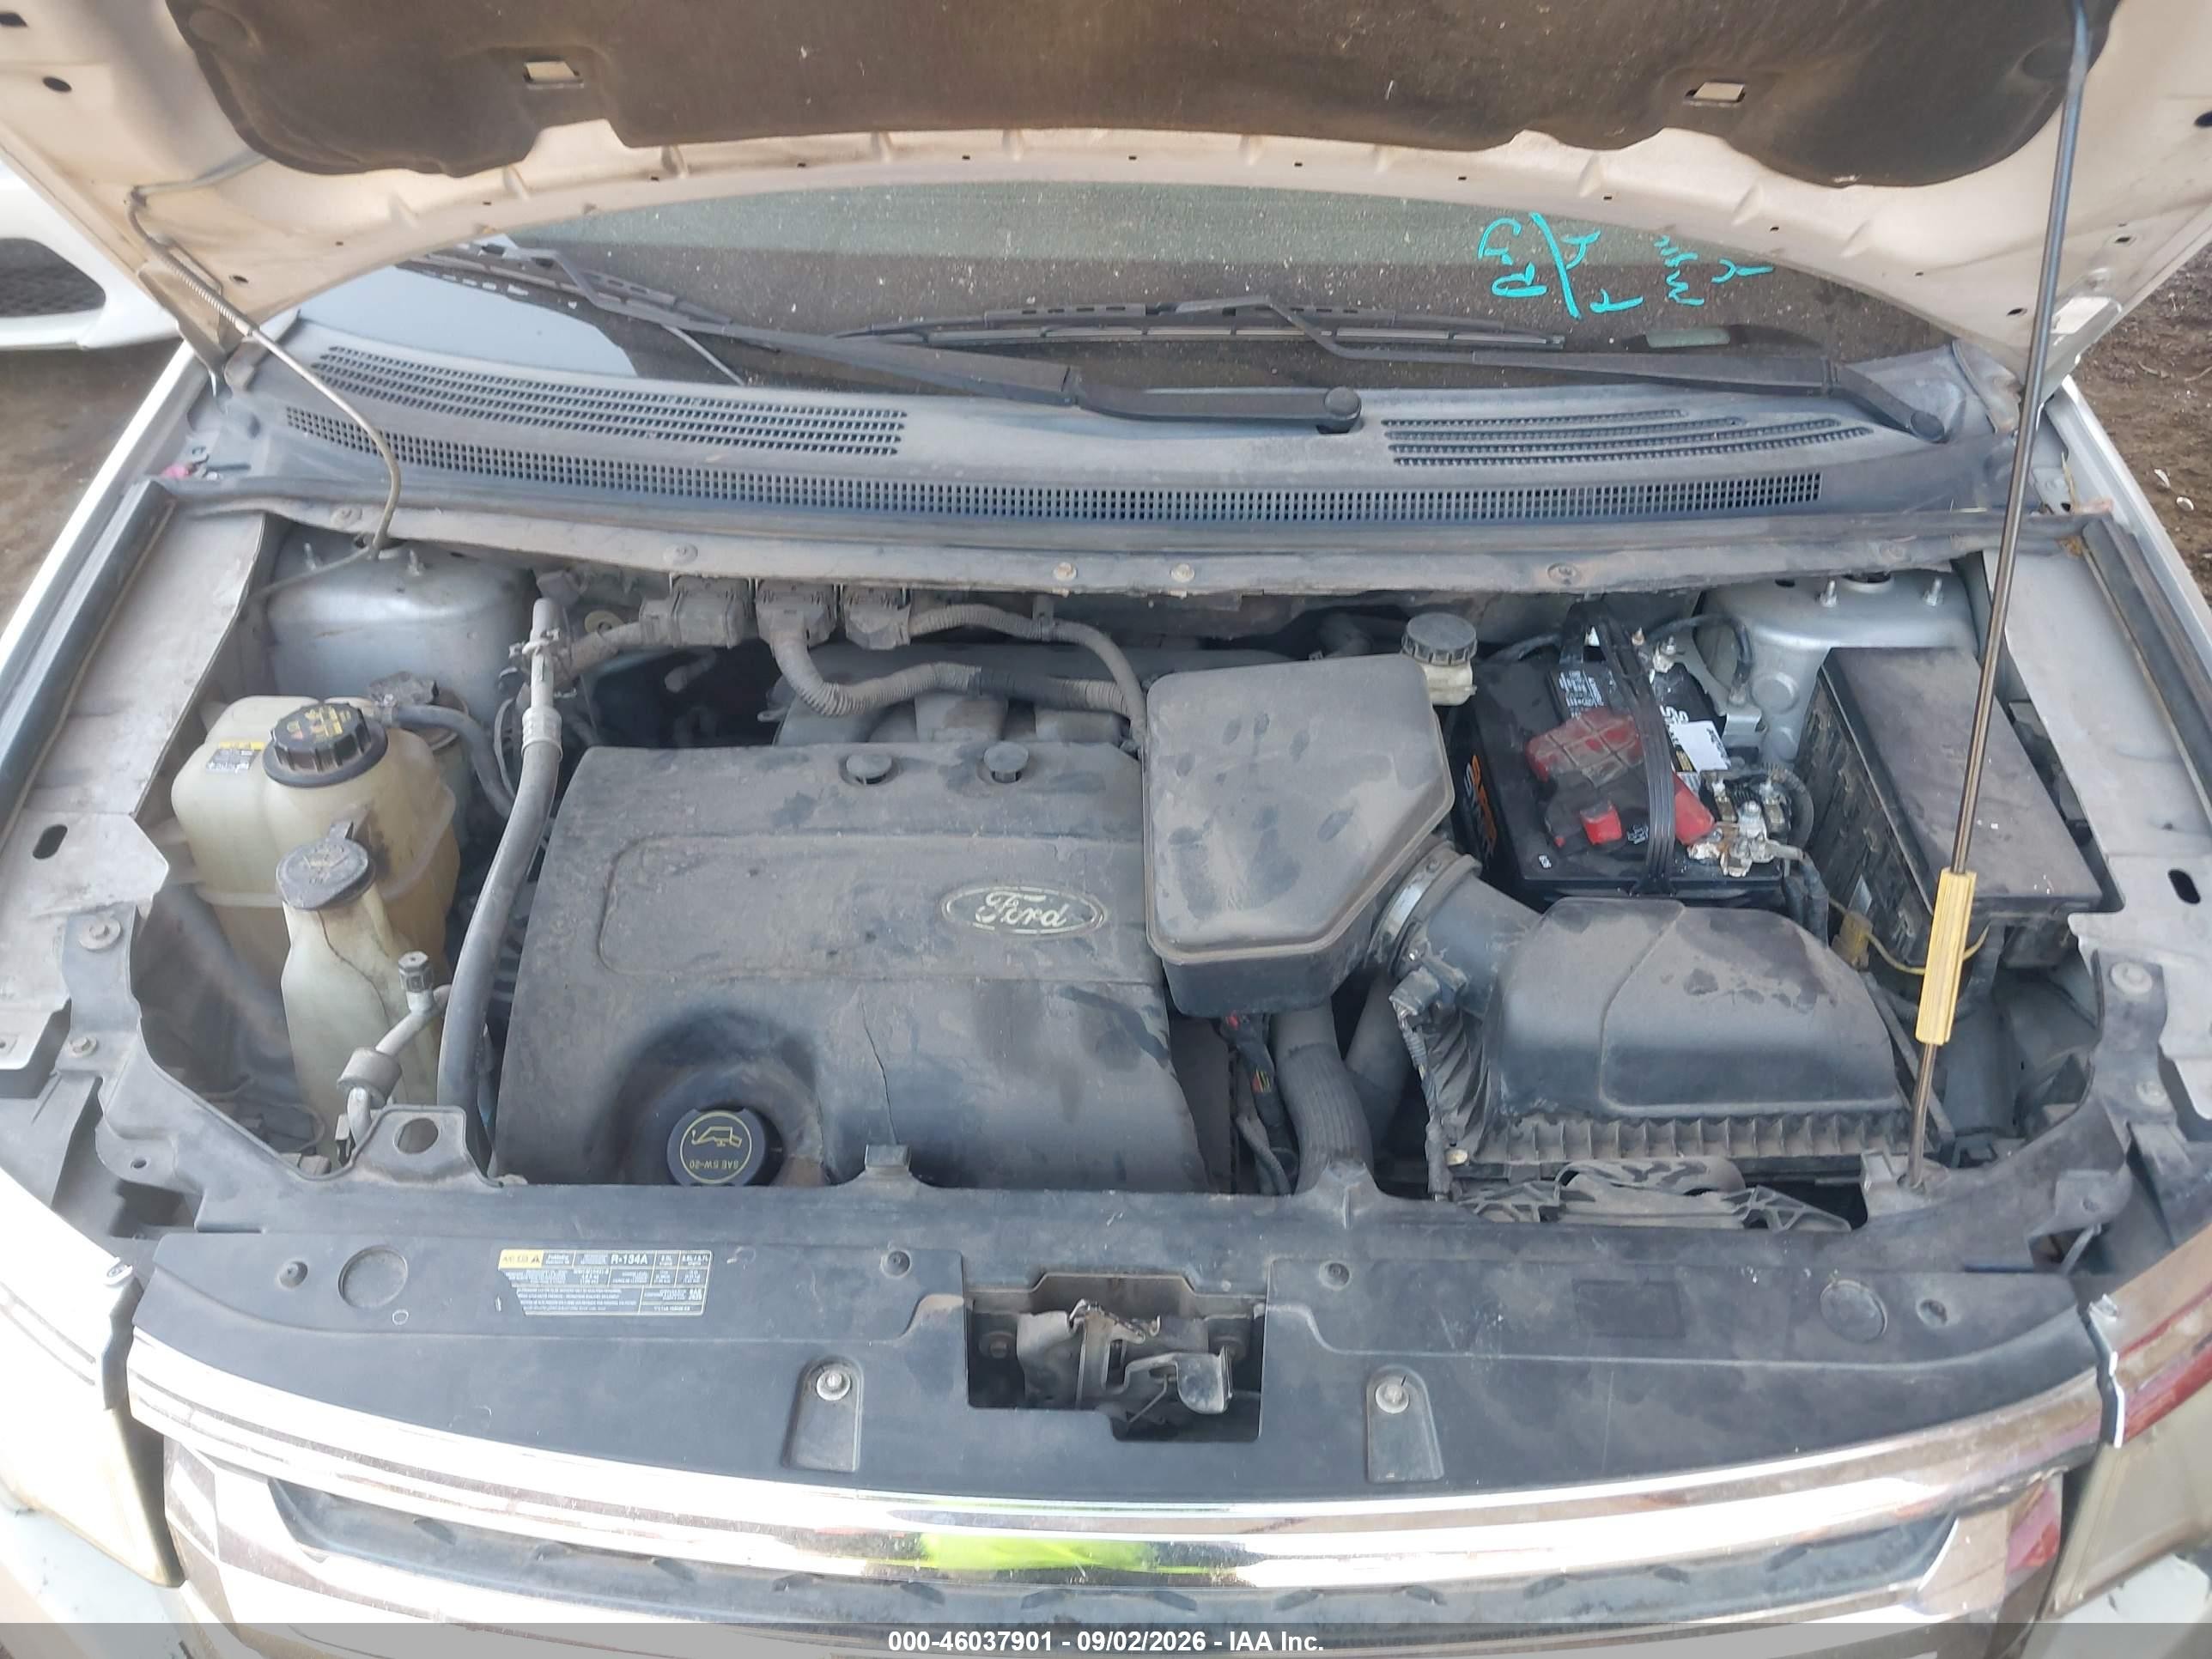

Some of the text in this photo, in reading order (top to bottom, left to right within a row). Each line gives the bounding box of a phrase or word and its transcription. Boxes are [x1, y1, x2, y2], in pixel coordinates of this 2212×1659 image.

[975, 890, 1069, 927] Ford
[690, 1159, 719, 1169] 5W-20
[611, 1254, 648, 1266] R-134A
